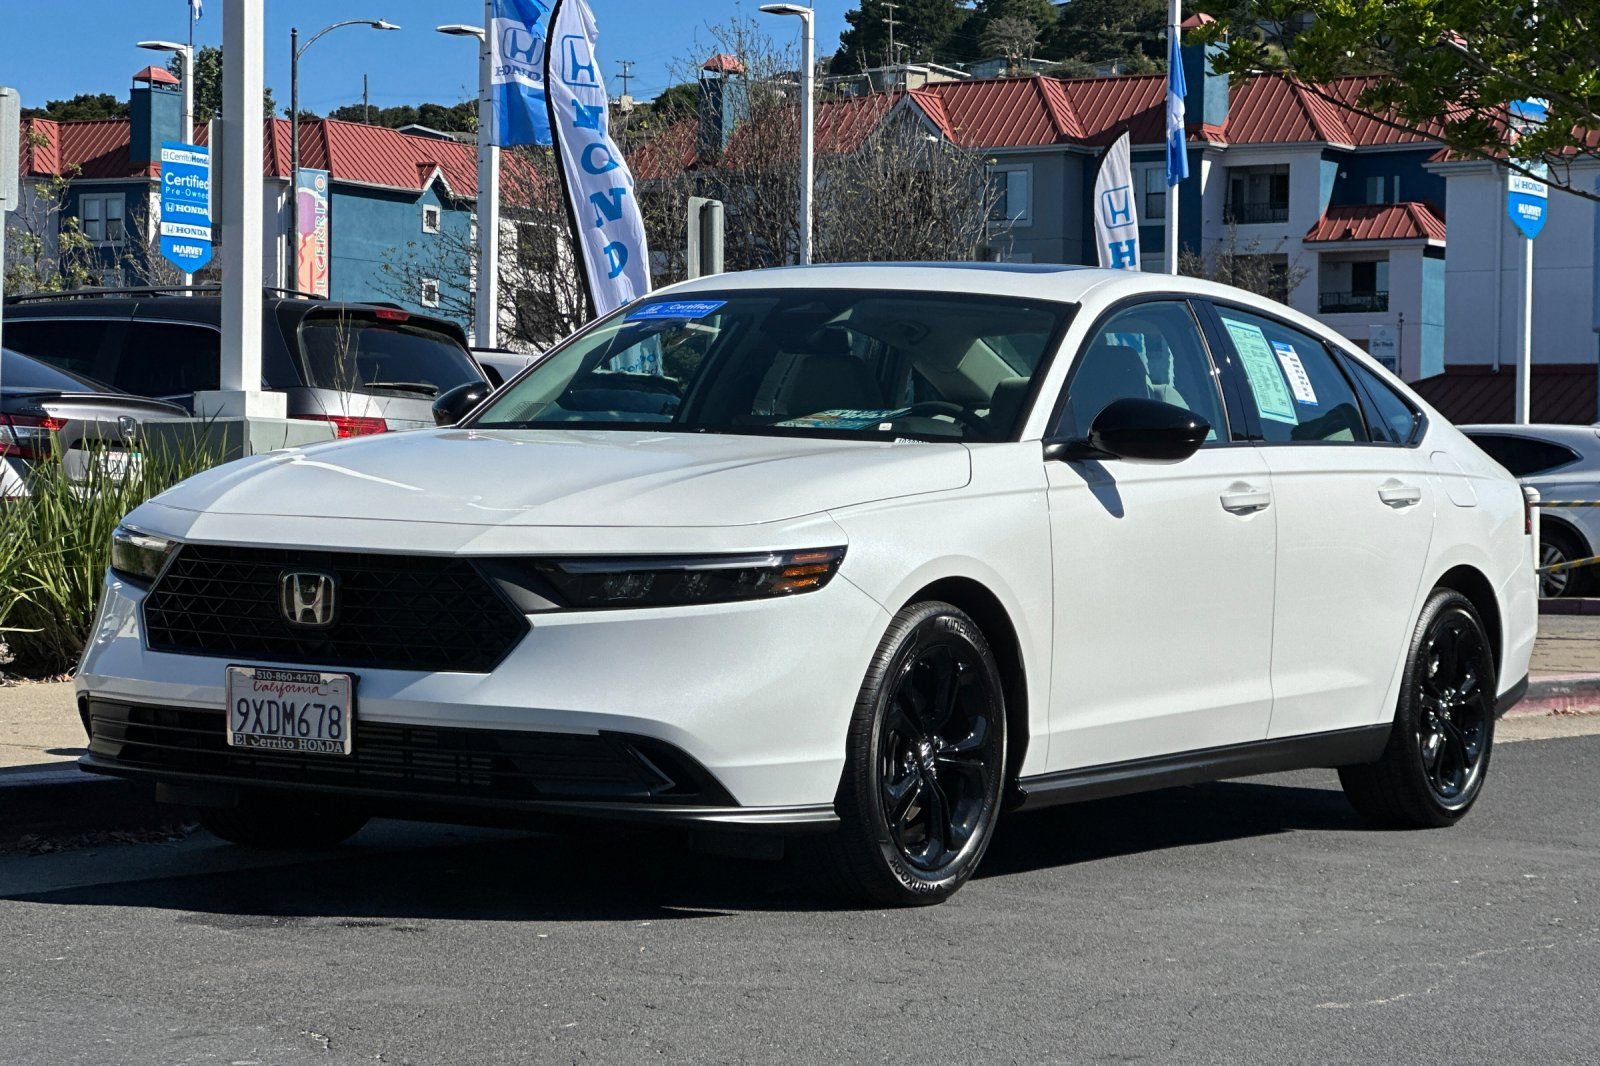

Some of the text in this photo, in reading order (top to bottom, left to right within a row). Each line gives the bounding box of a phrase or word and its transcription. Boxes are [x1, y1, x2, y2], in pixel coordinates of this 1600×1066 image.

[175, 203, 208, 216] HONDA
[176, 226, 208, 237] HONDA
[256, 671, 319, 684] 510-860-4470
[252, 680, 327, 699] California
[236, 697, 342, 739] 9XDM678
[234, 732, 343, 753] El Cerrito HONDA
